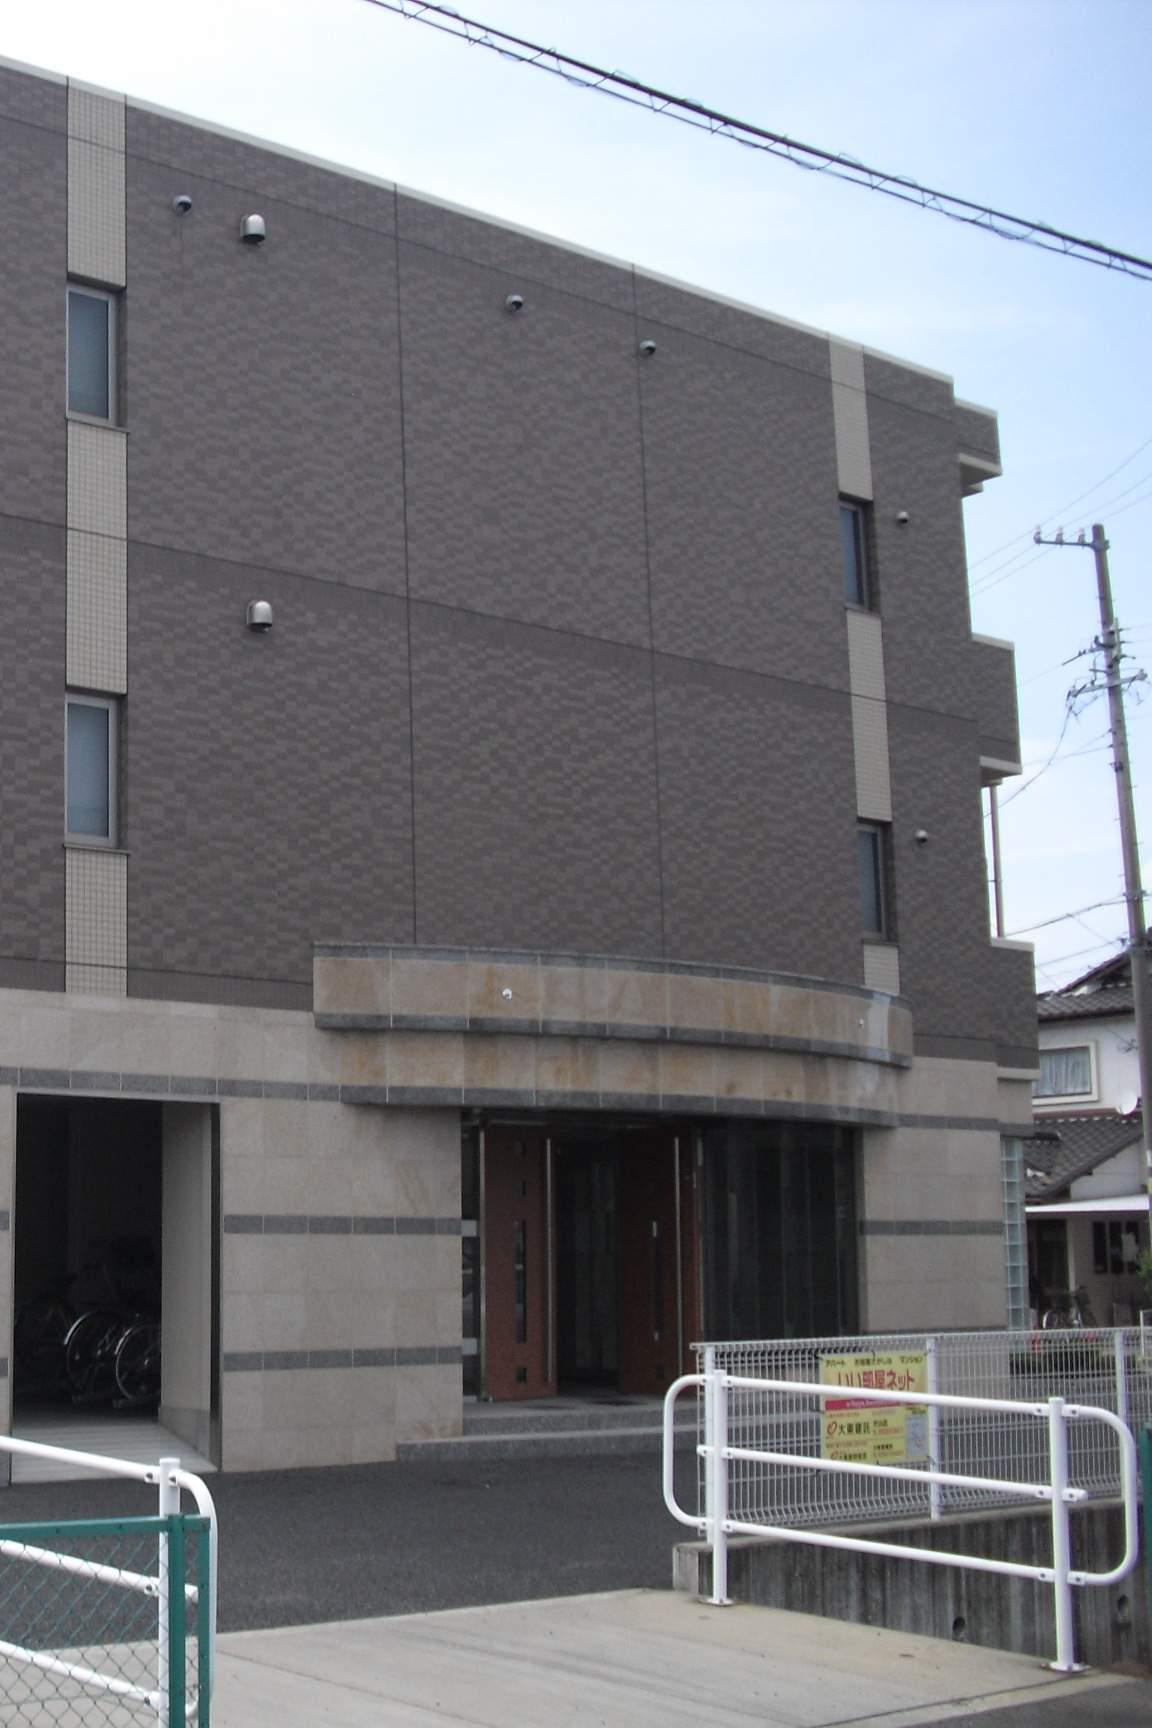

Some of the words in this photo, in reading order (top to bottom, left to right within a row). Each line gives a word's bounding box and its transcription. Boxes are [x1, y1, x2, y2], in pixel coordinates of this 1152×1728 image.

[837, 1368, 915, 1390] いい部屋ネット
